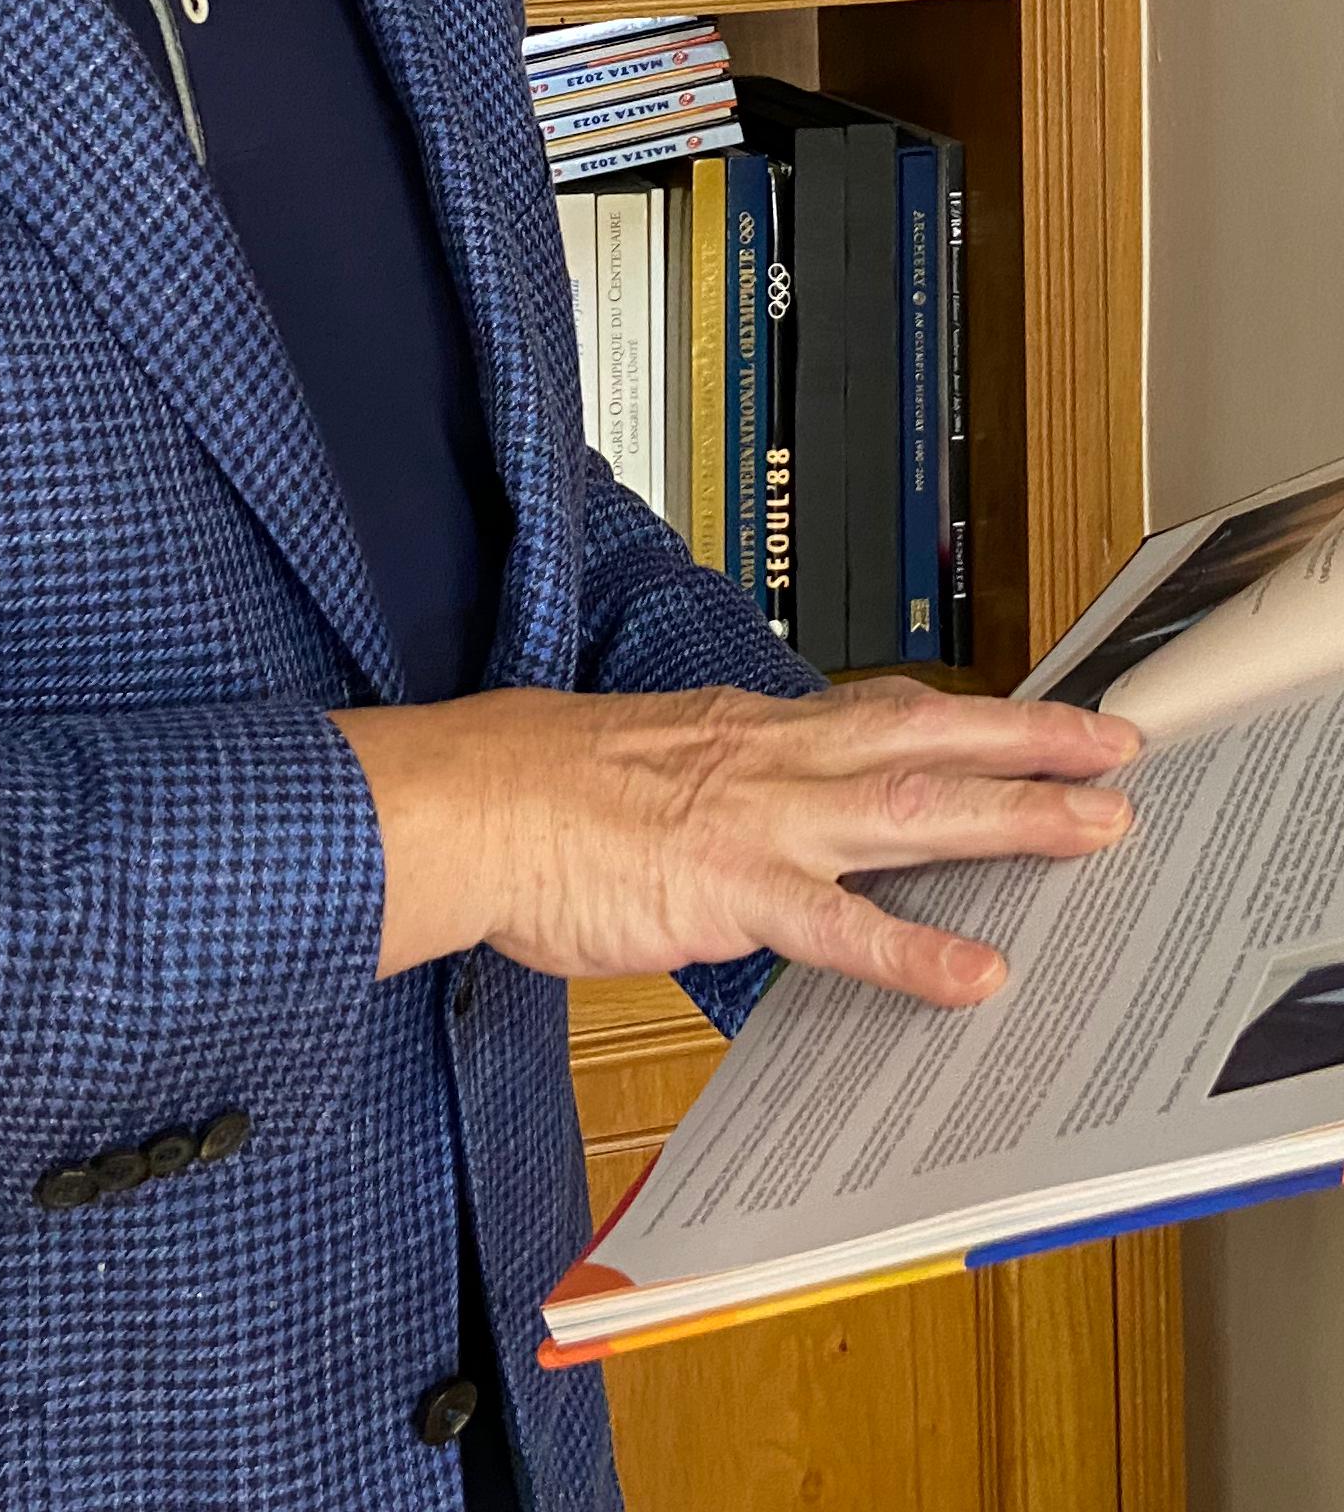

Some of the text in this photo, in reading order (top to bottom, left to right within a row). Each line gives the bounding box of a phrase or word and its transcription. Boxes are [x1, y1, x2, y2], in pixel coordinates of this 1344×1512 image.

[565, 69, 604, 89] 2023
[607, 55, 663, 80] MALTA
[572, 97, 669, 130] MALTA 2023
[579, 139, 677, 173] MALTA 2023
[912, 210, 926, 287] ARCHERY
[605, 211, 625, 415] OLYMPIQUE DU CENTENAIRE
[914, 311, 924, 328] AN
[913, 330, 925, 380] OLYMPIC
[738, 248, 757, 589] OMITE INTERNATIONAL OLYMPIQUE
[914, 384, 925, 431] HISTORY
[763, 447, 791, 588] SEOUL'88
